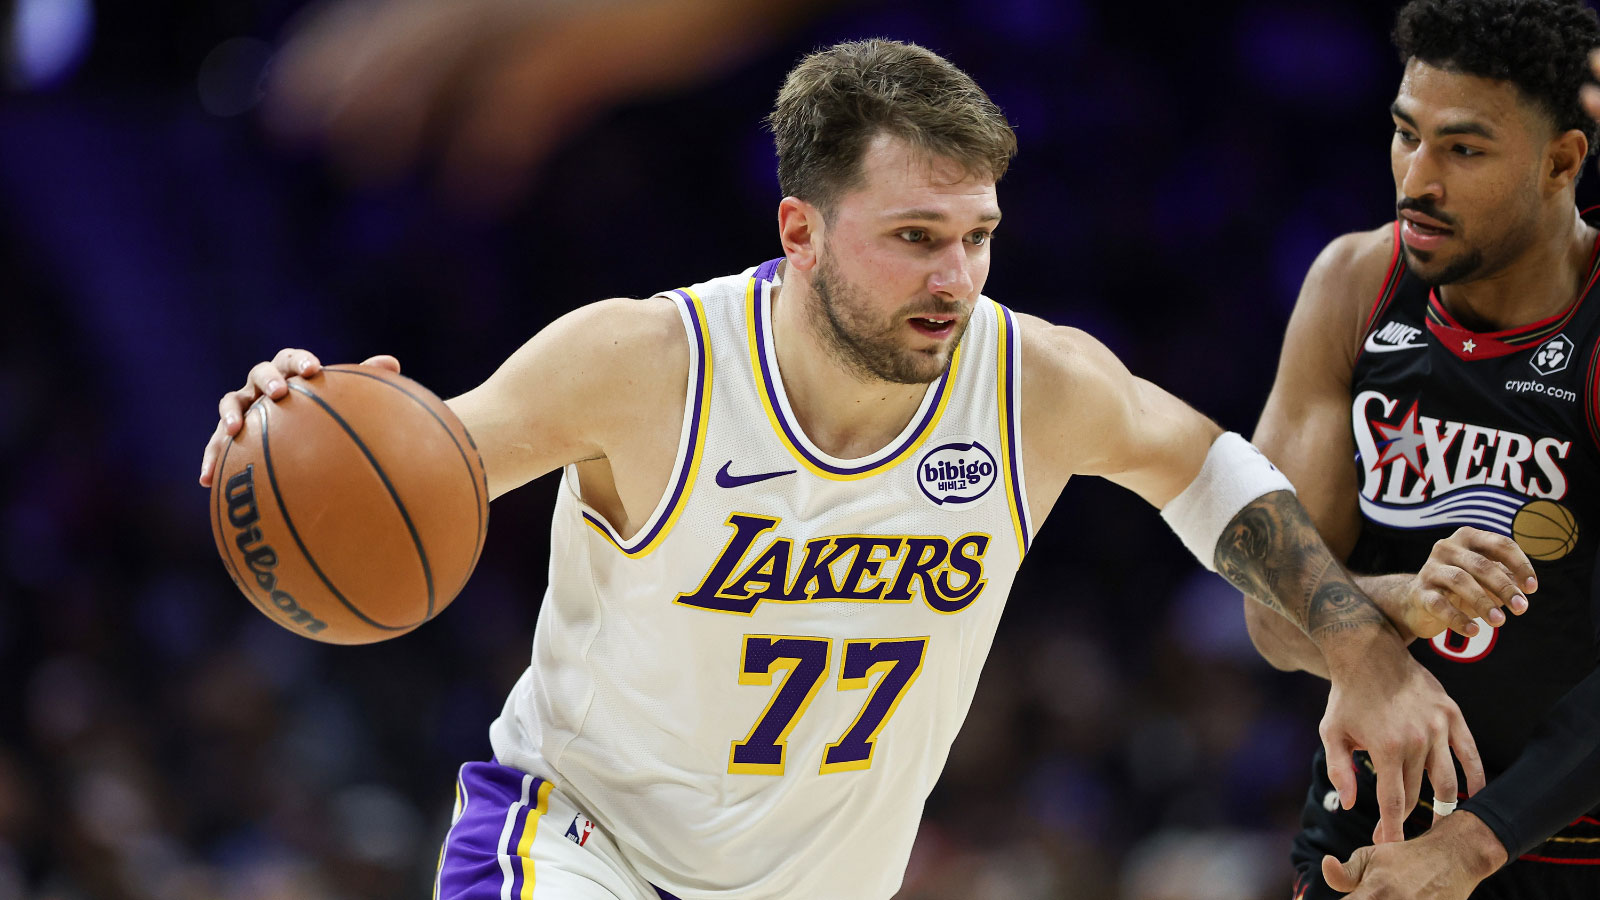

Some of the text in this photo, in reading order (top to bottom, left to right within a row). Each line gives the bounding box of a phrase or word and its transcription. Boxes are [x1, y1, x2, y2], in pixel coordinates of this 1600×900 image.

[1376, 321, 1422, 345] NIKE
[1505, 379, 1576, 402] crypto.com
[924, 459, 992, 484] bibigo
[938, 480, 967, 491] 비비고
[225, 463, 328, 635] Wilson
[672, 512, 992, 617] LAKERS
[728, 634, 930, 776] 77
